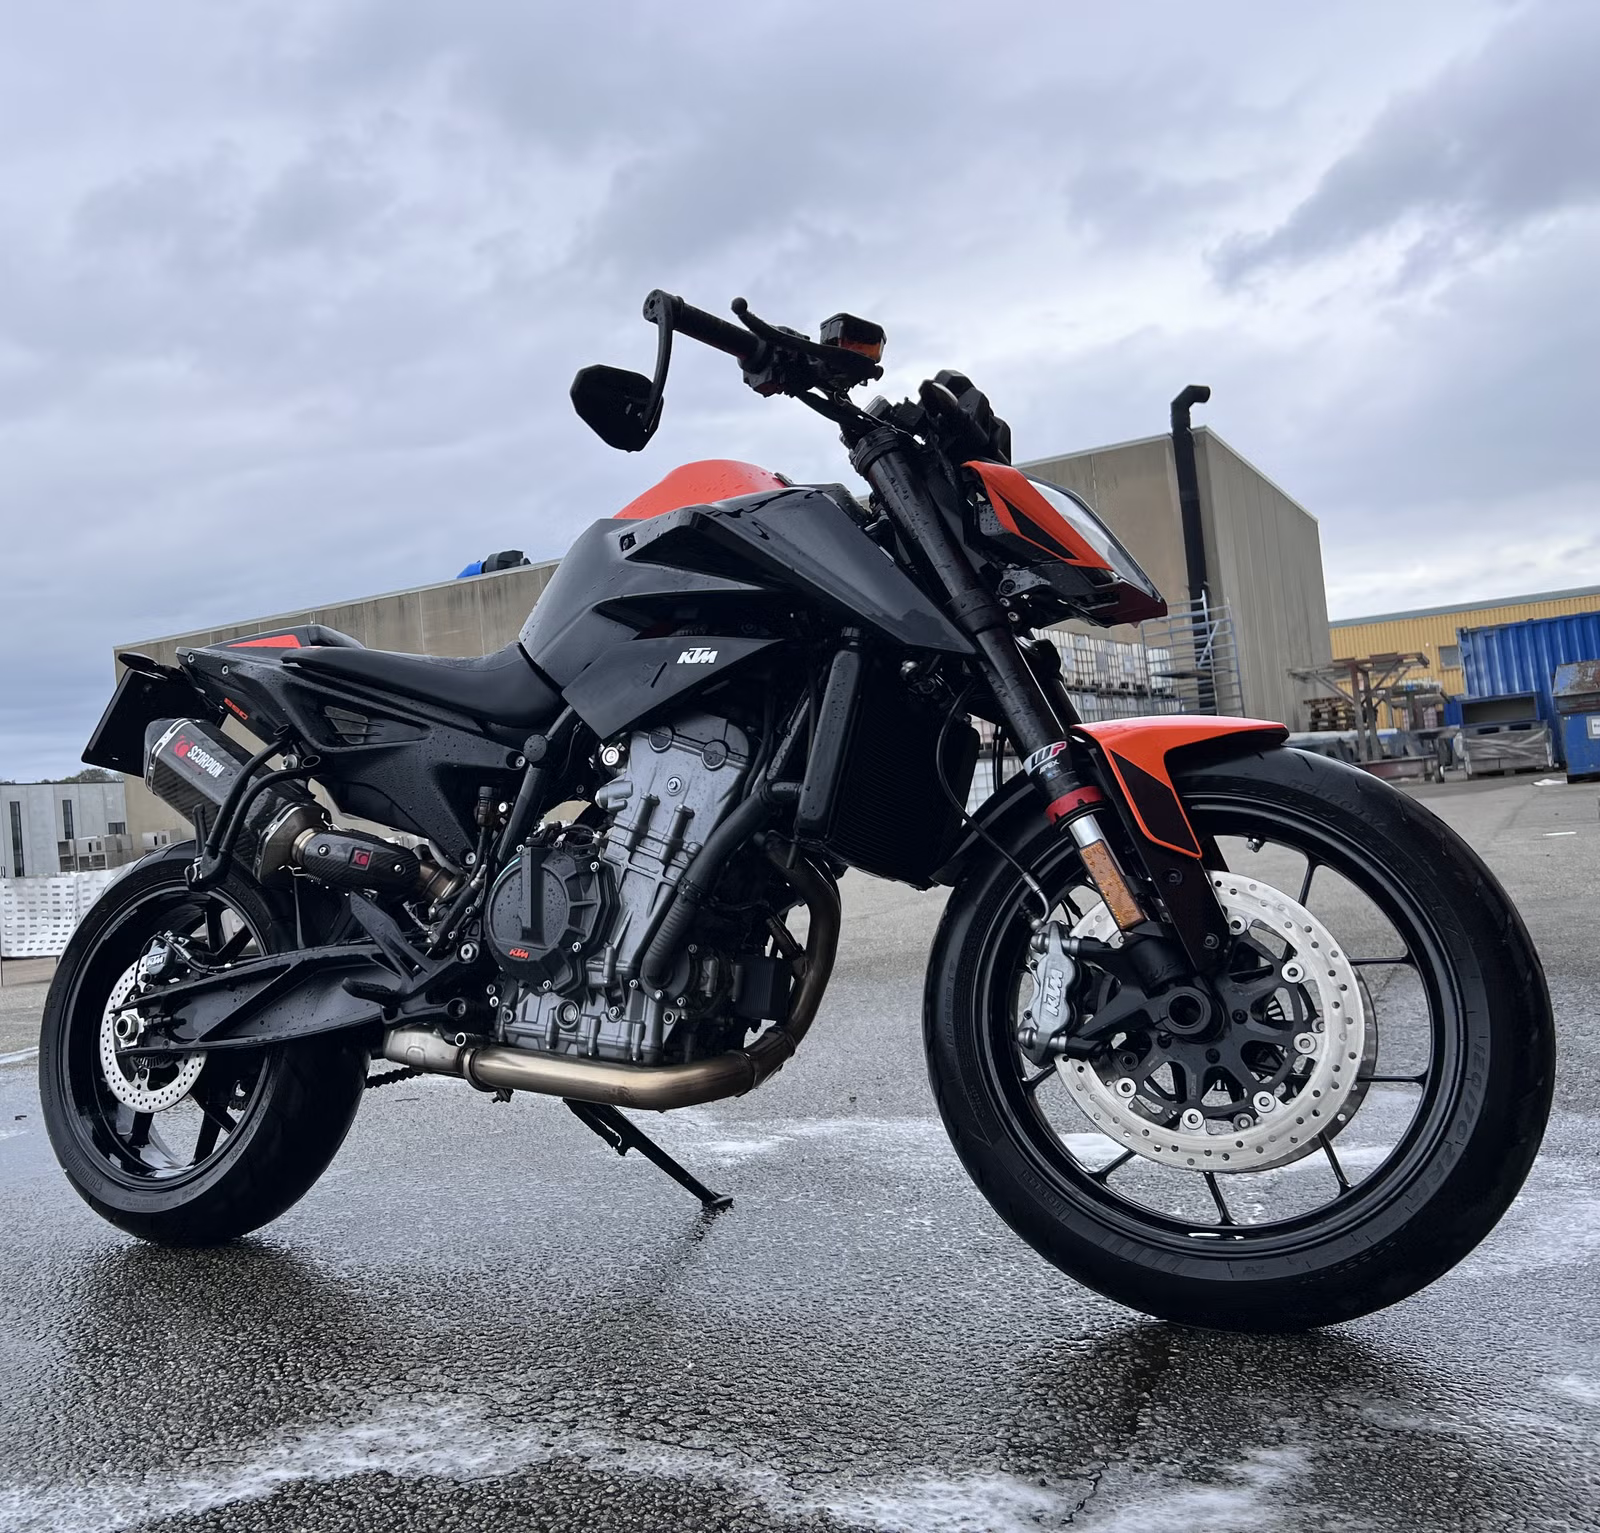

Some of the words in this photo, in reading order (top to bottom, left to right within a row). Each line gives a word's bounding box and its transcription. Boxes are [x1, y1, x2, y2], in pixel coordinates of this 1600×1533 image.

[676, 647, 718, 664] KTM
[187, 745, 225, 778] SCORPION
[1030, 741, 1067, 770] WP
[1039, 759, 1060, 774] APEX
[146, 954, 164, 966] KTM
[508, 947, 529, 959] KTM
[1043, 968, 1064, 1017] KTM
